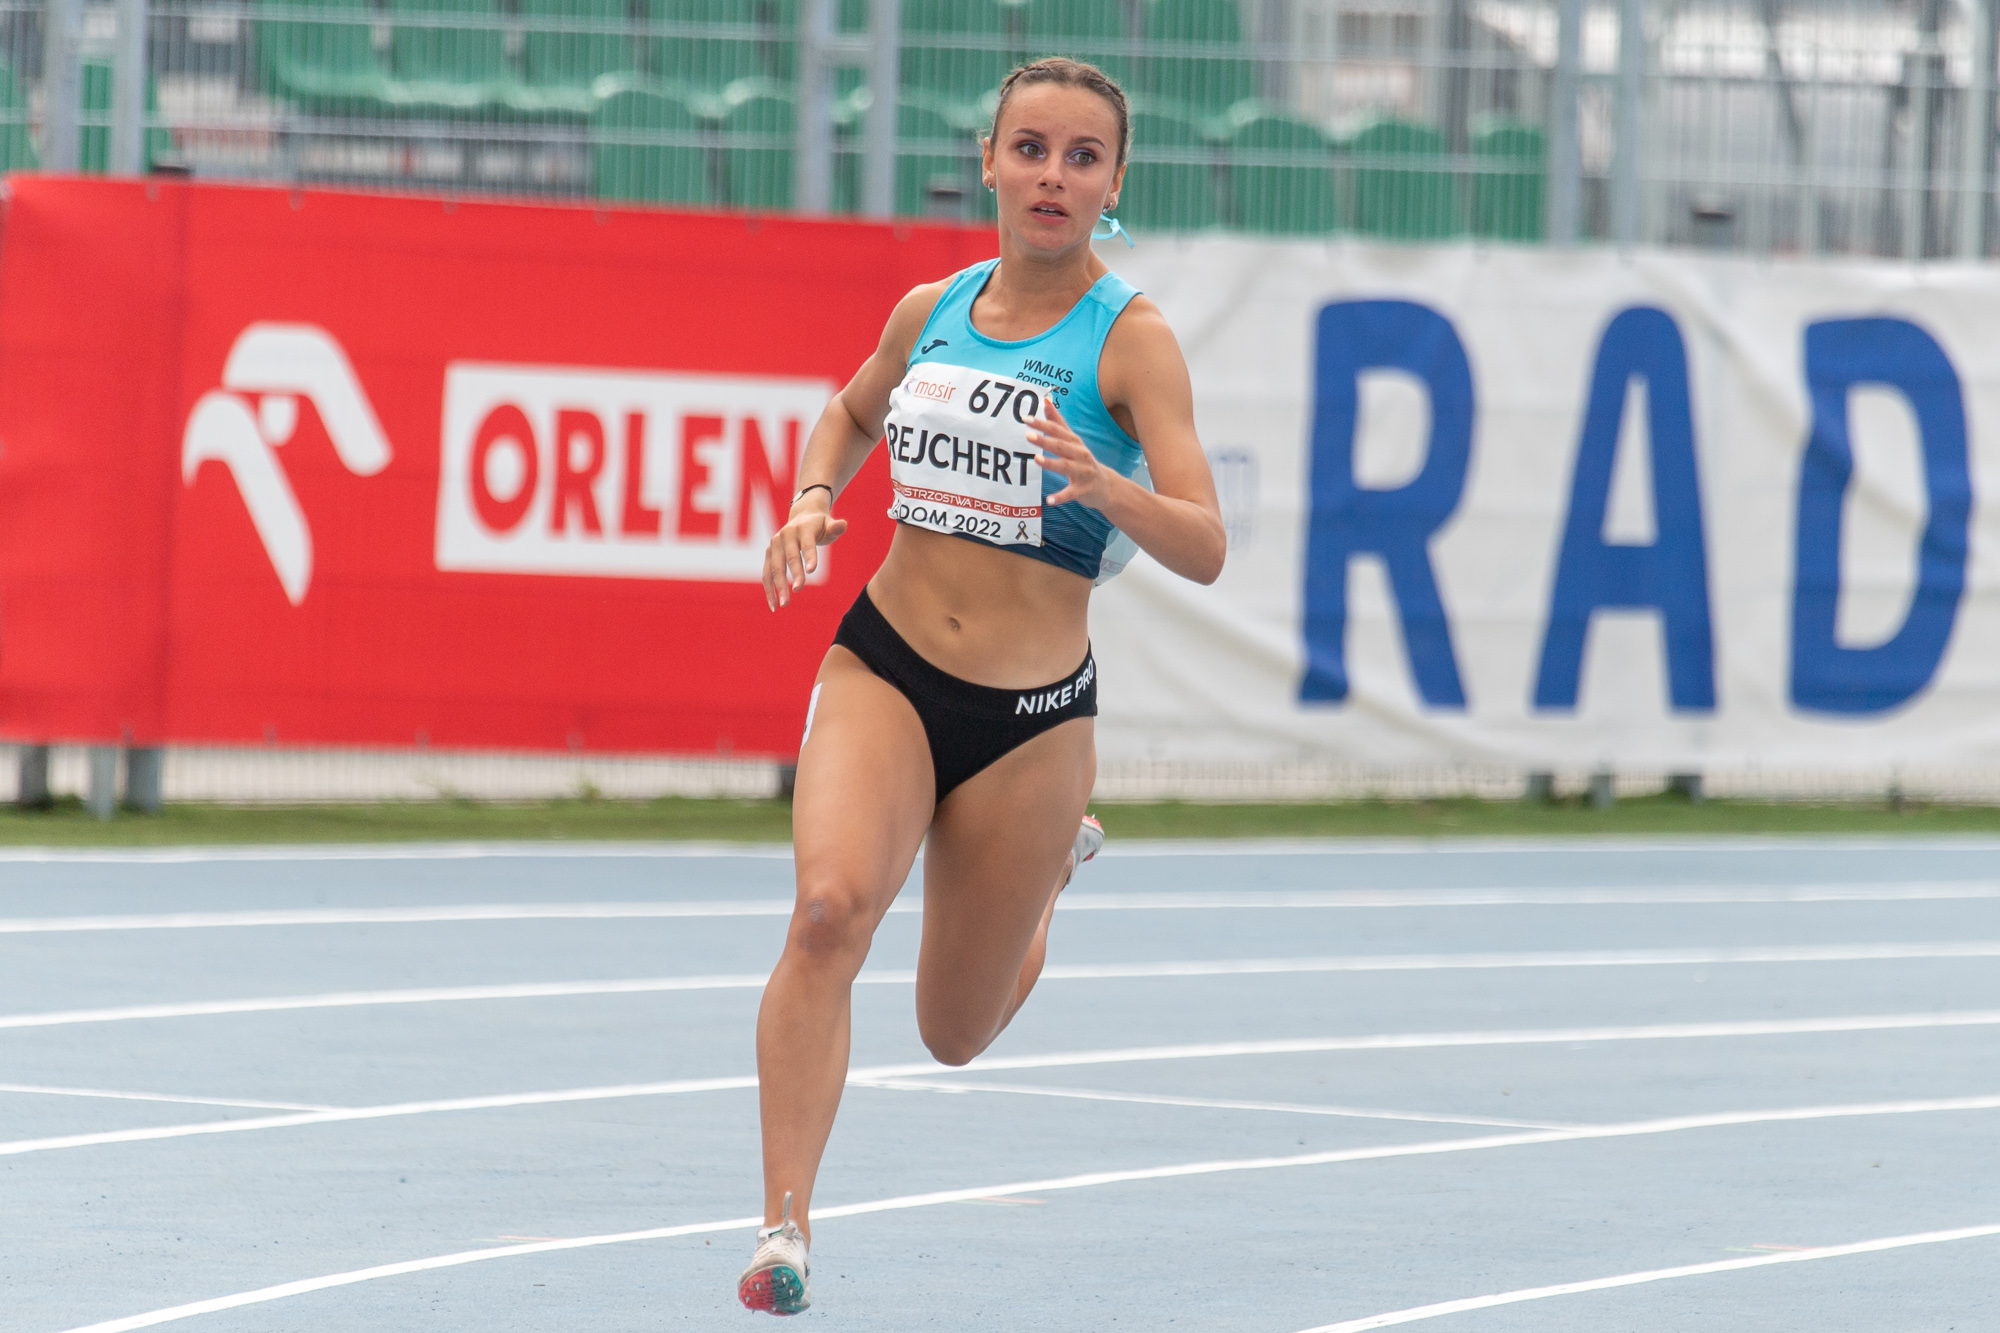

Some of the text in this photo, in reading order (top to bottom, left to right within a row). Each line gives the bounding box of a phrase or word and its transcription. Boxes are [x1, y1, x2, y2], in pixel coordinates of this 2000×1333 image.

[914, 380, 957, 401] mosir
[1023, 359, 1074, 384] WMLKS
[968, 379, 1040, 425] 670
[471, 403, 802, 541] ORLEN
[887, 422, 1036, 487] REJCHERT
[894, 502, 1001, 539] DOM 2022
[903, 487, 972, 508] STRZOSTWA
[974, 499, 1010, 516] POLSKI
[1012, 507, 1038, 517] U20
[1298, 298, 1974, 717] RAD
[1015, 658, 1094, 715] NIKE PRO
